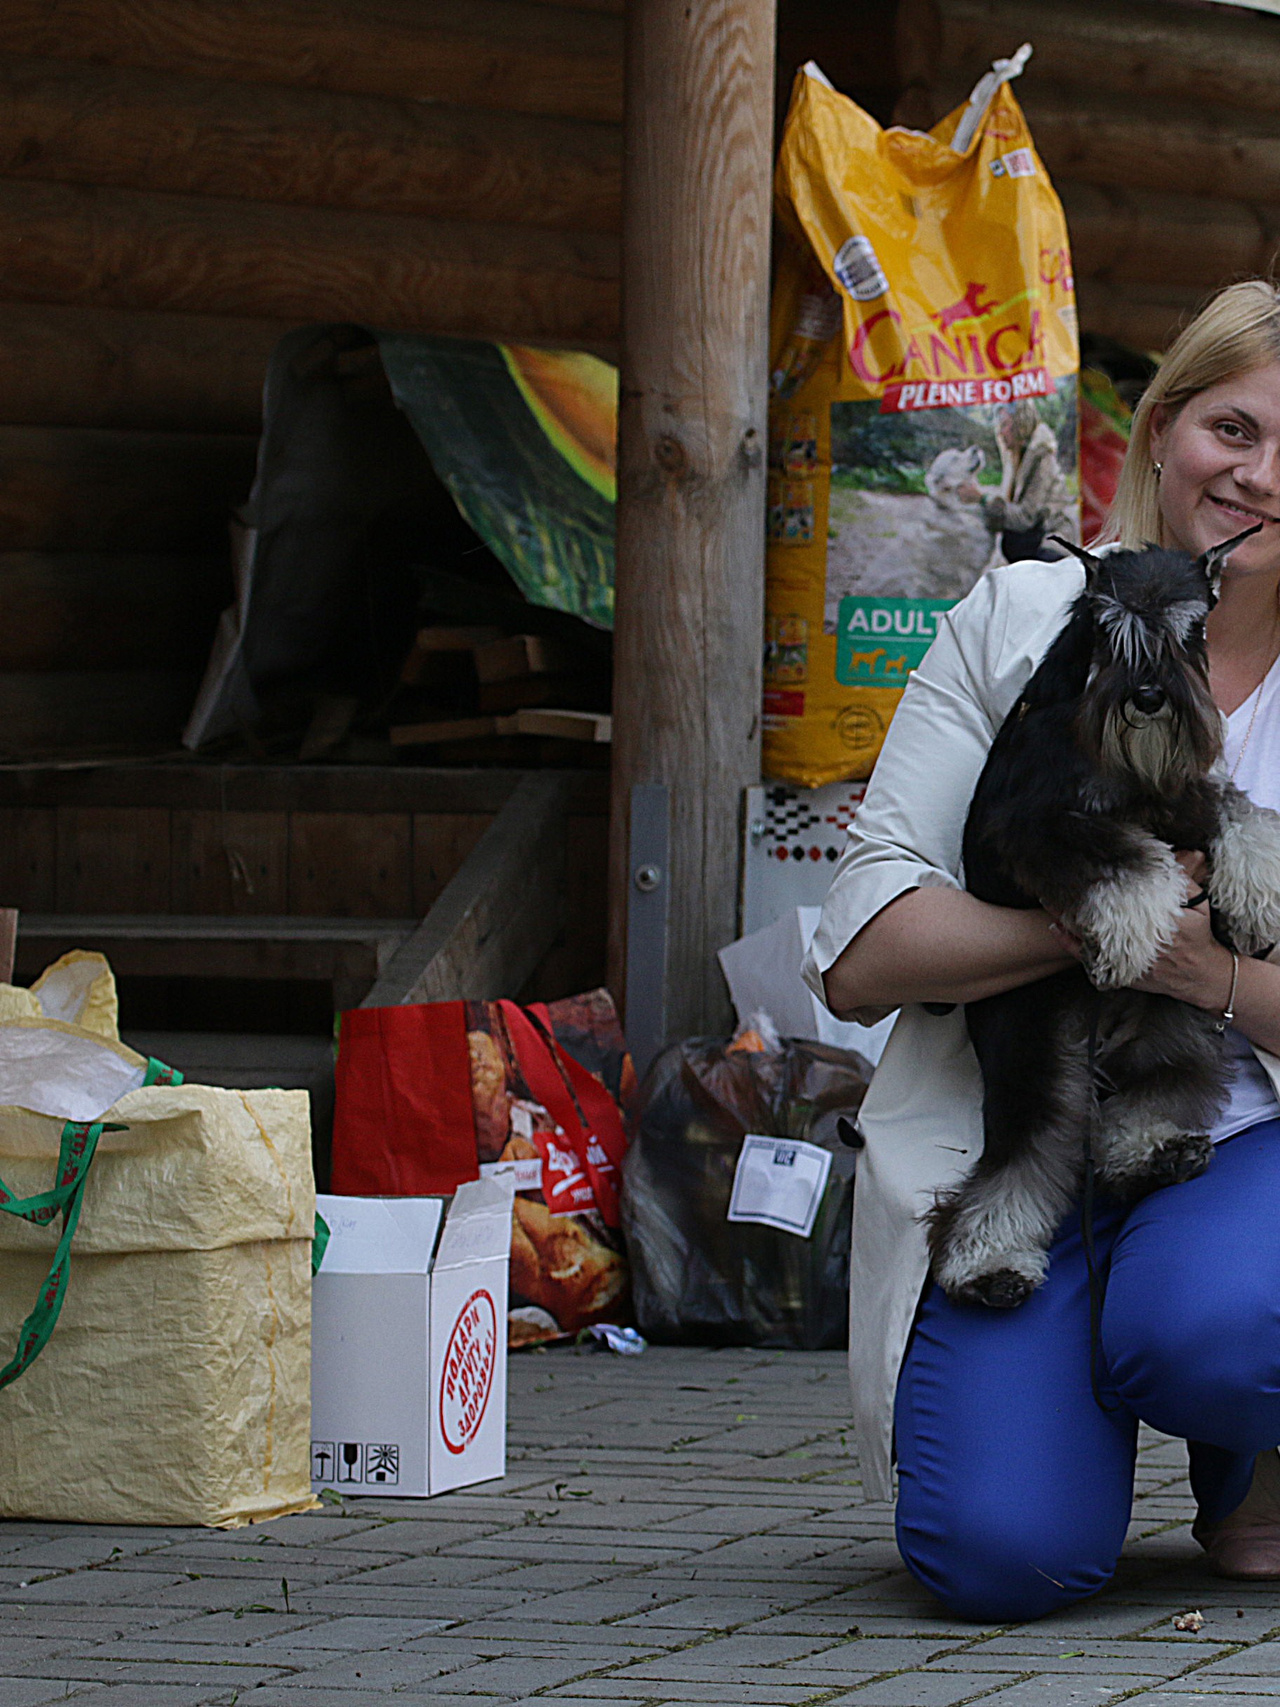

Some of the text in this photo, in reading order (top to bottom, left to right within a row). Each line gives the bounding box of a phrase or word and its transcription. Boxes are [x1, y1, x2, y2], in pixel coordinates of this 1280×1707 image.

[897, 380, 977, 410] PLEINE
[847, 607, 946, 635] ADULT
[446, 1305, 481, 1401] ПОДАРИ
[458, 1337, 482, 1408] ДРУГУ
